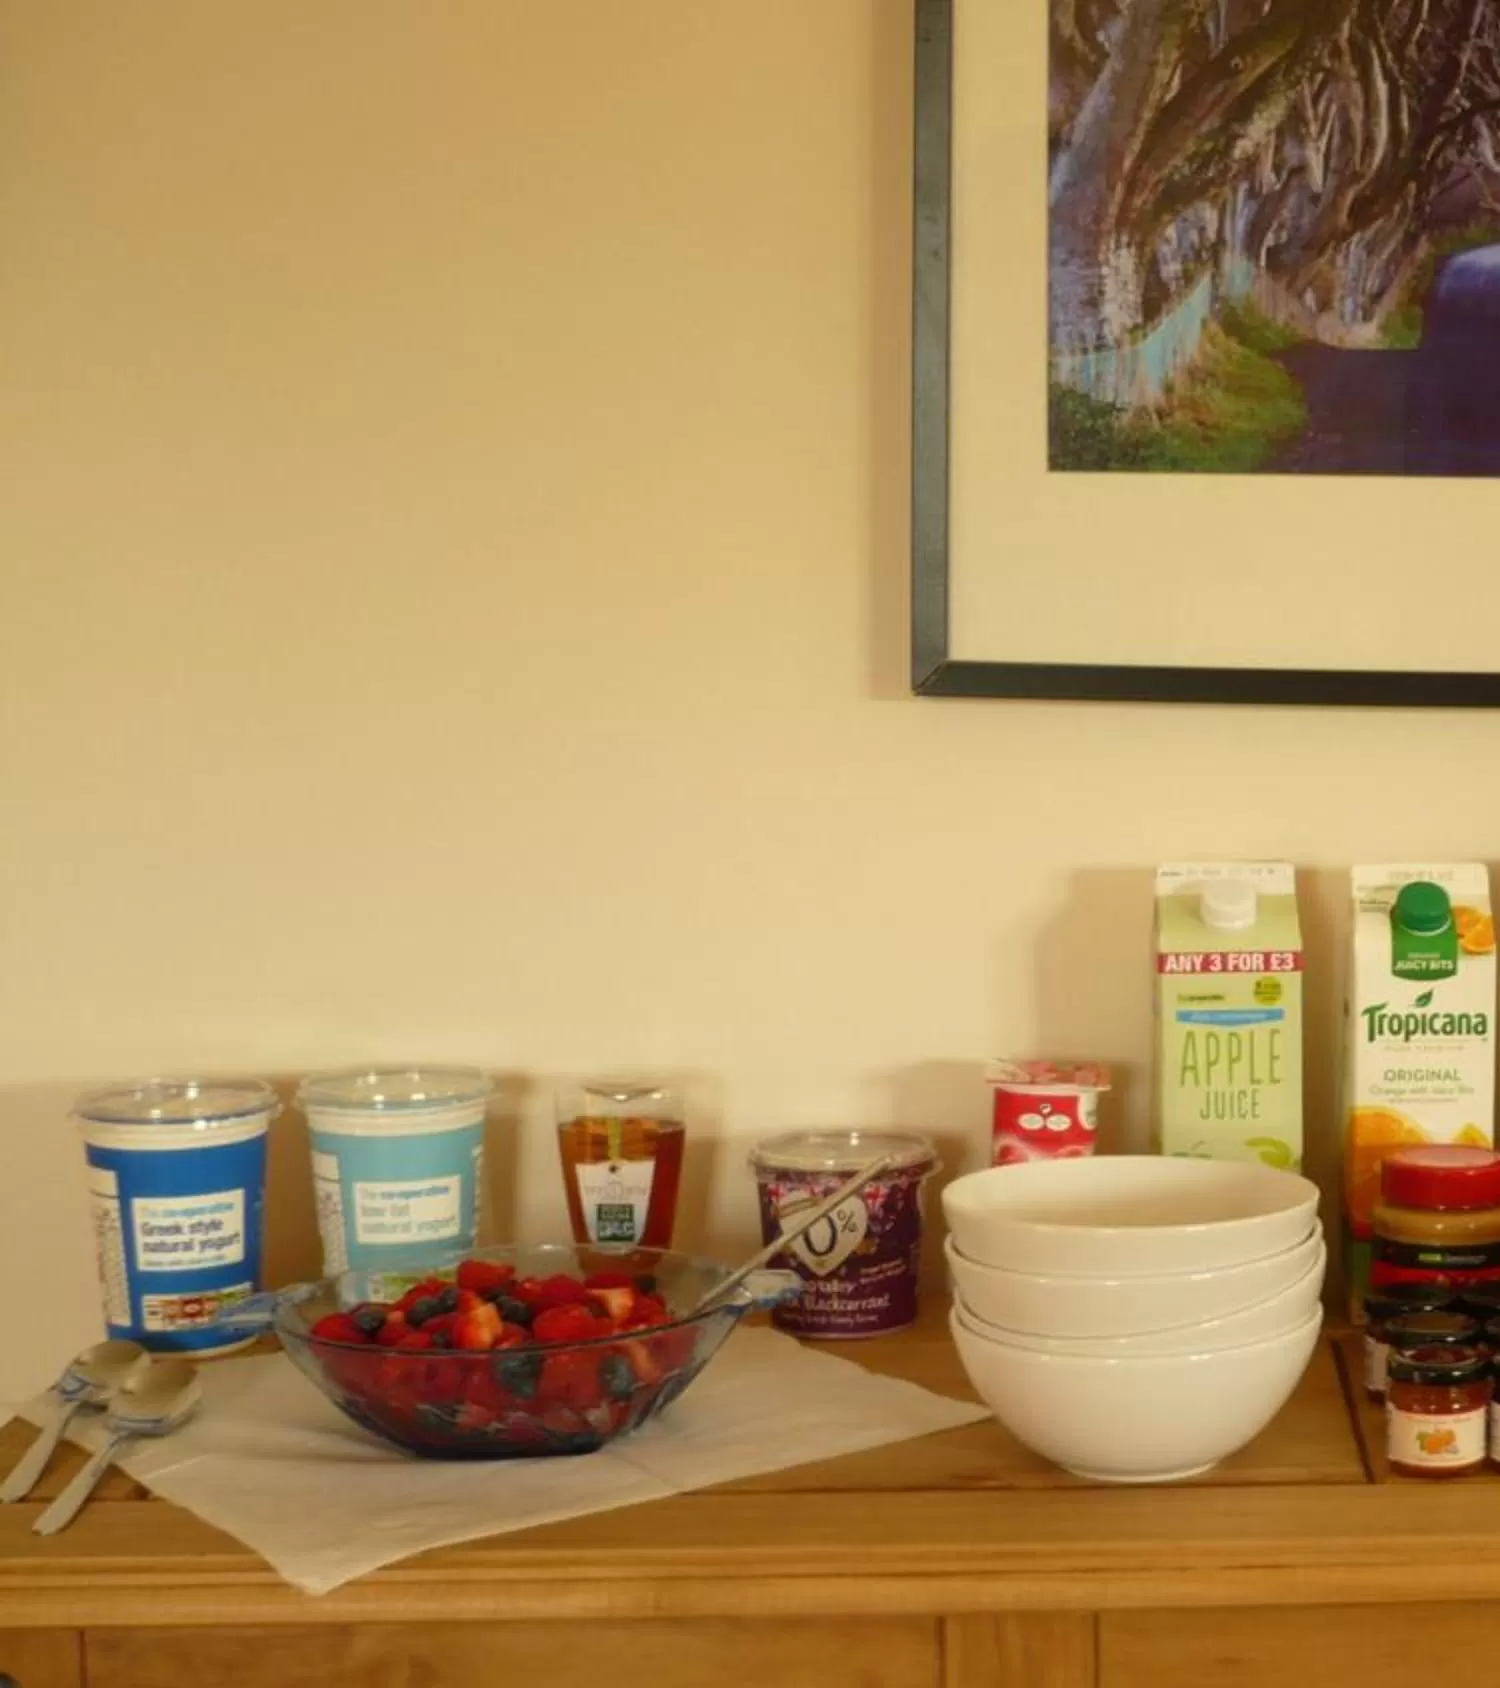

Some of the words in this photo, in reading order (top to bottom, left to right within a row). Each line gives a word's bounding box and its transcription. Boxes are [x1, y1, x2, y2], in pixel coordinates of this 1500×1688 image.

[1165, 953, 1204, 971] ANY
[1209, 954, 1222, 971] 3
[1227, 953, 1265, 970] FOR
[1361, 1002, 1488, 1042] Tropicana
[1180, 1028, 1281, 1087] APPLE
[1383, 1068, 1462, 1082] ORIGINAL
[1200, 1089, 1261, 1120] JUICE
[361, 1221, 412, 1234] natural
[416, 1217, 457, 1233] yogurt
[143, 1239, 195, 1253] natural
[199, 1232, 241, 1253] yogurt
